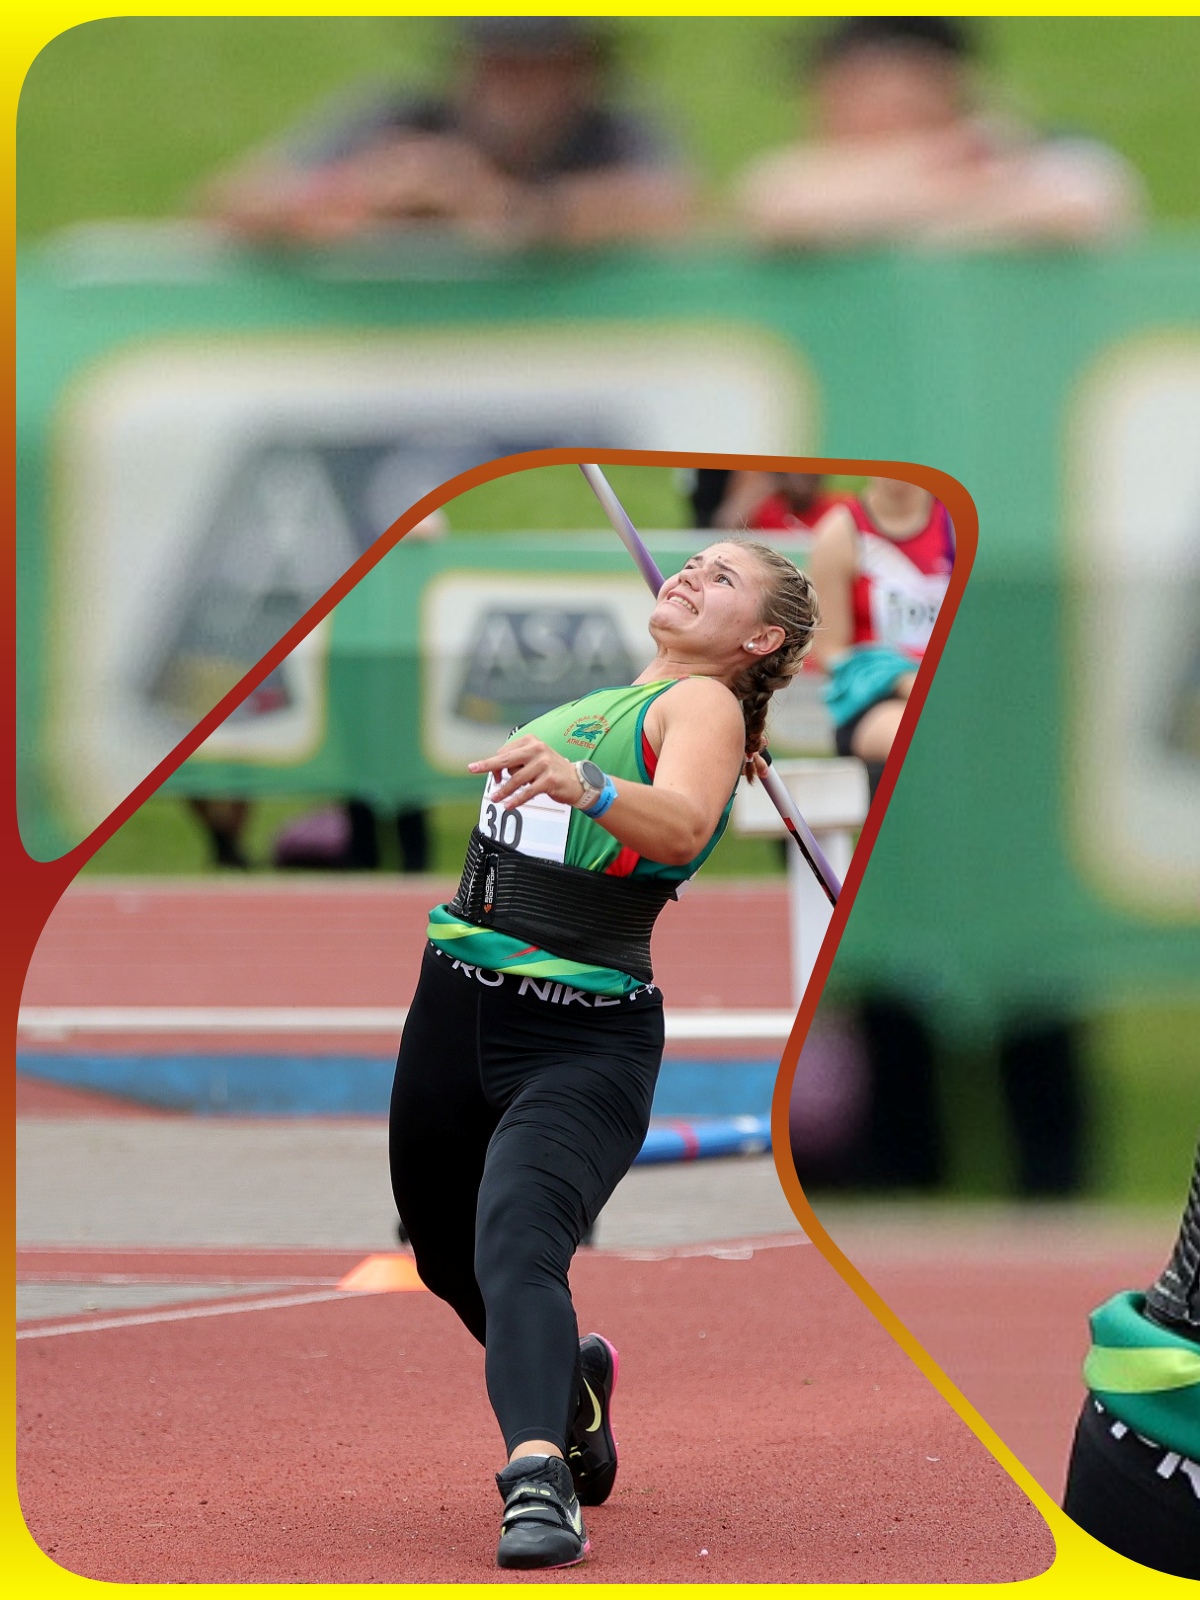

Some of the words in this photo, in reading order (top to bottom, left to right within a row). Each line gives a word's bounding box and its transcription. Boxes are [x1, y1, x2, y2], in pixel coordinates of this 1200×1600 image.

[473, 612, 624, 683] ASA
[566, 738, 596, 749] ATHLETICS
[486, 803, 523, 850] 30
[517, 977, 621, 1008] NIKE
